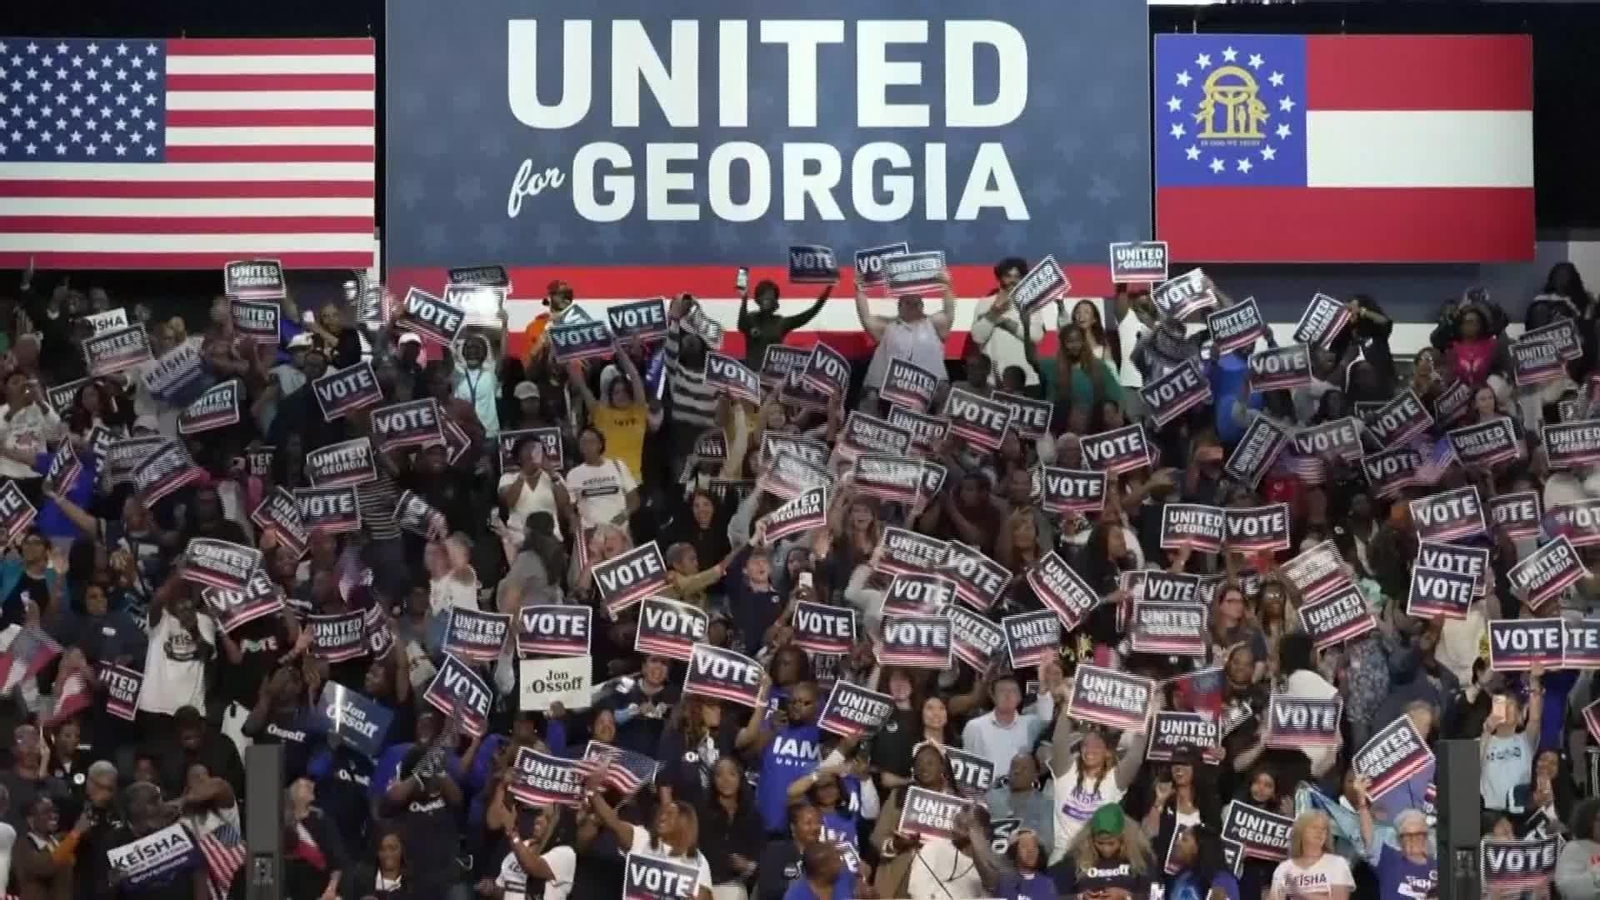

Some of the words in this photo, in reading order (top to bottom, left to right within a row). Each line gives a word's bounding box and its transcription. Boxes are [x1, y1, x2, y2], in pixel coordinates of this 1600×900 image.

[508, 20, 1028, 128] UNITED
[508, 160, 565, 217] for
[573, 142, 1030, 220] GEORGIA
[791, 252, 834, 269] VOTE
[1117, 248, 1163, 261] UNITED
[1123, 260, 1163, 268] GEORGIA
[231, 266, 278, 278] UNITED
[1161, 276, 1204, 310] VOTE
[408, 297, 462, 332] VOTE
[610, 305, 662, 329] VOTE
[1211, 307, 1254, 332] UNITED
[1299, 300, 1330, 343] UNITED
[553, 327, 605, 348] VOTE
[1252, 353, 1306, 374] VOTE
[1518, 345, 1557, 361] UNITED
[318, 368, 373, 402] VOTE
[711, 358, 756, 390] VOTE
[894, 366, 934, 389] UNITED
[1146, 370, 1196, 408] VOTE
[377, 410, 435, 432] VOTE
[952, 397, 1005, 428] VOTE
[1369, 398, 1419, 437] VOTE
[853, 420, 907, 446] UNITED
[894, 415, 943, 438] UNITED
[1300, 424, 1355, 454] VOTE
[1455, 426, 1504, 448] UNITED
[313, 446, 367, 466] UNITED
[1086, 432, 1141, 460] VOTE
[322, 459, 368, 475] GEORGIA
[1048, 476, 1101, 497] VOTE
[301, 494, 353, 516] VOTE
[772, 504, 820, 522] GEORGIA
[1417, 495, 1478, 526] VOTE
[1170, 510, 1221, 527] UNITED
[1176, 523, 1219, 536] GEORGIA
[1229, 513, 1284, 536] VOTE
[195, 544, 252, 568] UNITED
[1421, 550, 1482, 575] VOTE
[1517, 546, 1569, 583] UNITED
[601, 552, 660, 593] VOTE
[949, 549, 1001, 594] VOTE
[893, 581, 950, 606] VOTE
[1043, 561, 1093, 610] UNITED
[1149, 580, 1195, 601] VOTE
[1417, 575, 1469, 603] VOTE
[1141, 610, 1201, 627] UNITED
[1309, 591, 1360, 626] UNITED
[1321, 606, 1365, 635] GEORGIA
[313, 618, 361, 637] UNITED
[455, 613, 505, 634] UNITED
[523, 613, 585, 636] VOTE
[645, 606, 706, 639] VOTE
[798, 609, 850, 636] VOTE
[947, 607, 999, 646] UNITED
[884, 624, 948, 648] VOTE
[1493, 627, 1561, 651] VOTE
[546, 670, 569, 681] Jon
[696, 653, 759, 685] VOTE
[443, 668, 488, 716] VOTE
[532, 677, 582, 694] Ossoff
[1082, 672, 1148, 701] UNITED
[344, 701, 366, 721] Jon
[839, 691, 891, 718] UNITED
[1086, 690, 1143, 713] GEORGIA
[1276, 701, 1335, 729] VOTE
[1160, 718, 1216, 738] UNITED
[1359, 730, 1412, 771] UNITED
[1369, 742, 1419, 778] GEORGIA
[525, 775, 582, 796] GEORGIA
[113, 833, 185, 869] KEISHA
[1487, 847, 1556, 872] VOTE
[630, 864, 693, 897] VOTE
[1087, 864, 1131, 879] Ossoff
